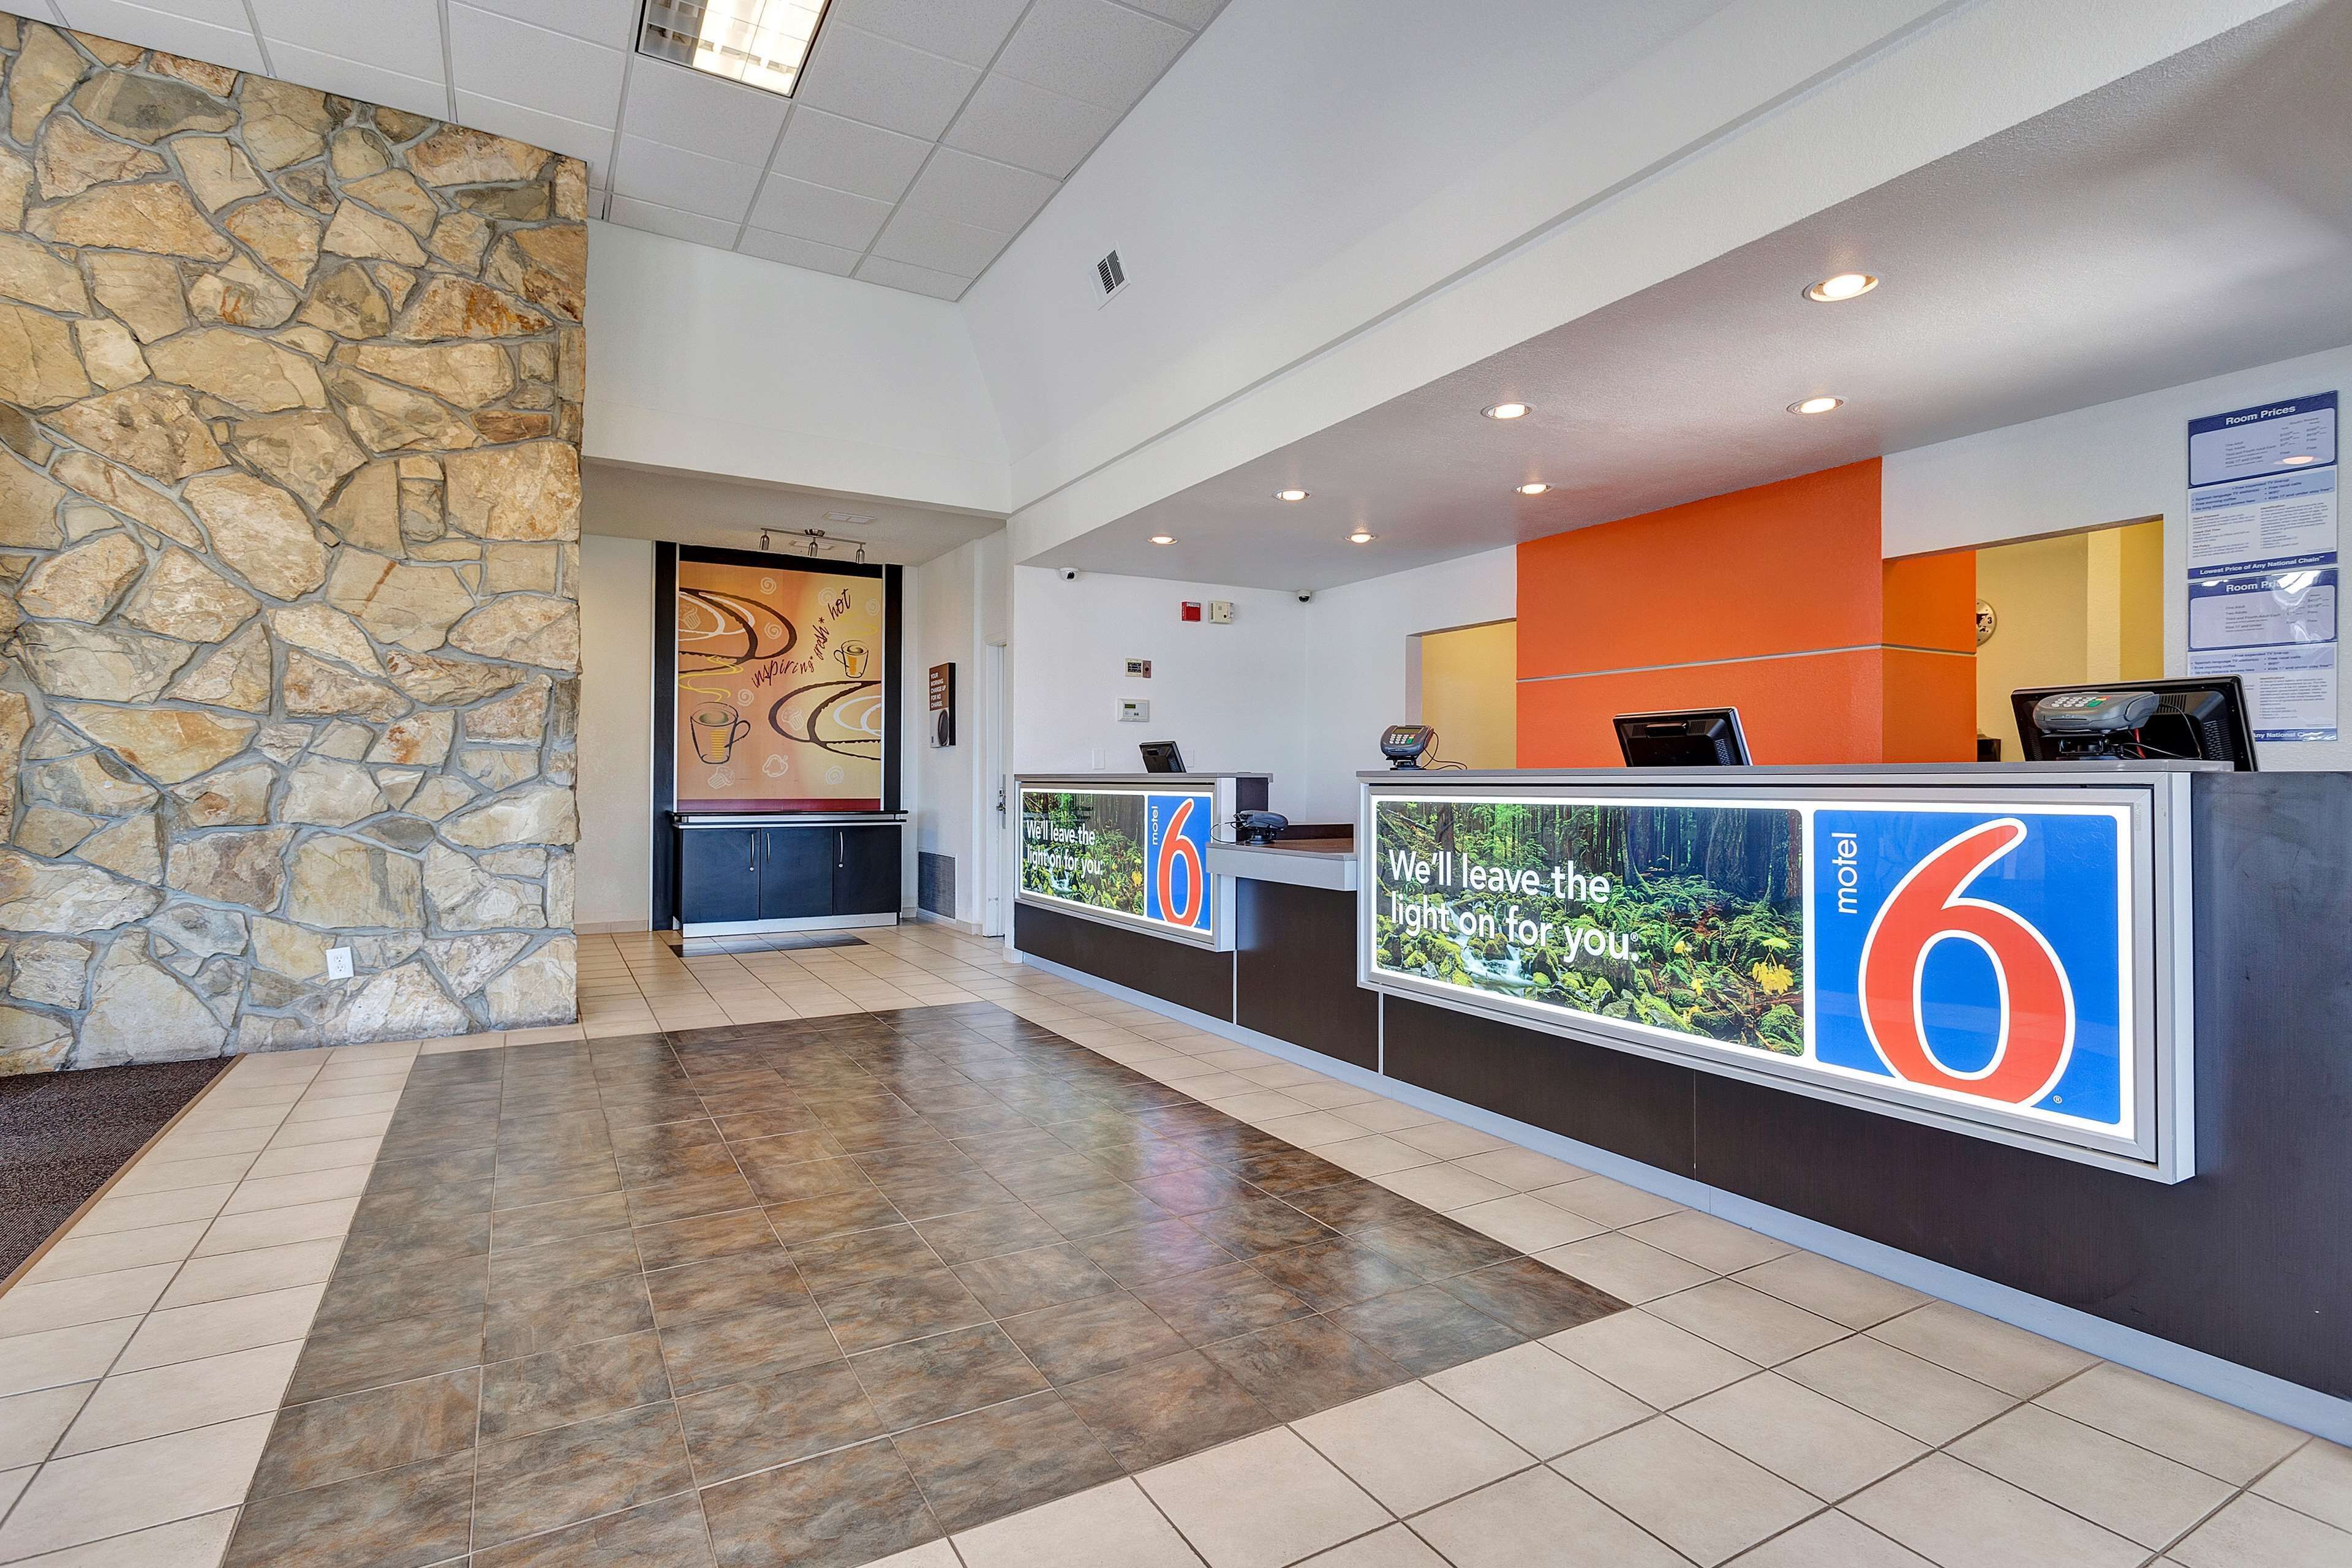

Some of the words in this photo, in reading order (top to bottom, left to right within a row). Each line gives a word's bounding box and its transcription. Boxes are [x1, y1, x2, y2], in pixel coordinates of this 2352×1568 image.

[2226, 413, 2258, 425] Room
[2260, 406, 2296, 418] Prices
[2267, 559, 2297, 567] National
[2226, 583, 2258, 592] Room
[827, 588, 851, 621] hot
[1027, 820, 1048, 840] We'll
[1050, 820, 1075, 844] leave
[1078, 823, 1095, 845] the
[1027, 844, 1047, 870] light
[1050, 853, 1061, 869] on
[1064, 848, 1079, 870] for
[1156, 797, 1204, 927] 6
[1389, 849, 1452, 886] We'll
[1462, 852, 1540, 896] leave
[1551, 860, 1611, 903] the
[1392, 891, 1450, 937] light
[1459, 911, 1495, 940] on
[1506, 905, 1553, 948] for
[1831, 832, 1858, 914] motel
[1858, 816, 2076, 1107] 6
